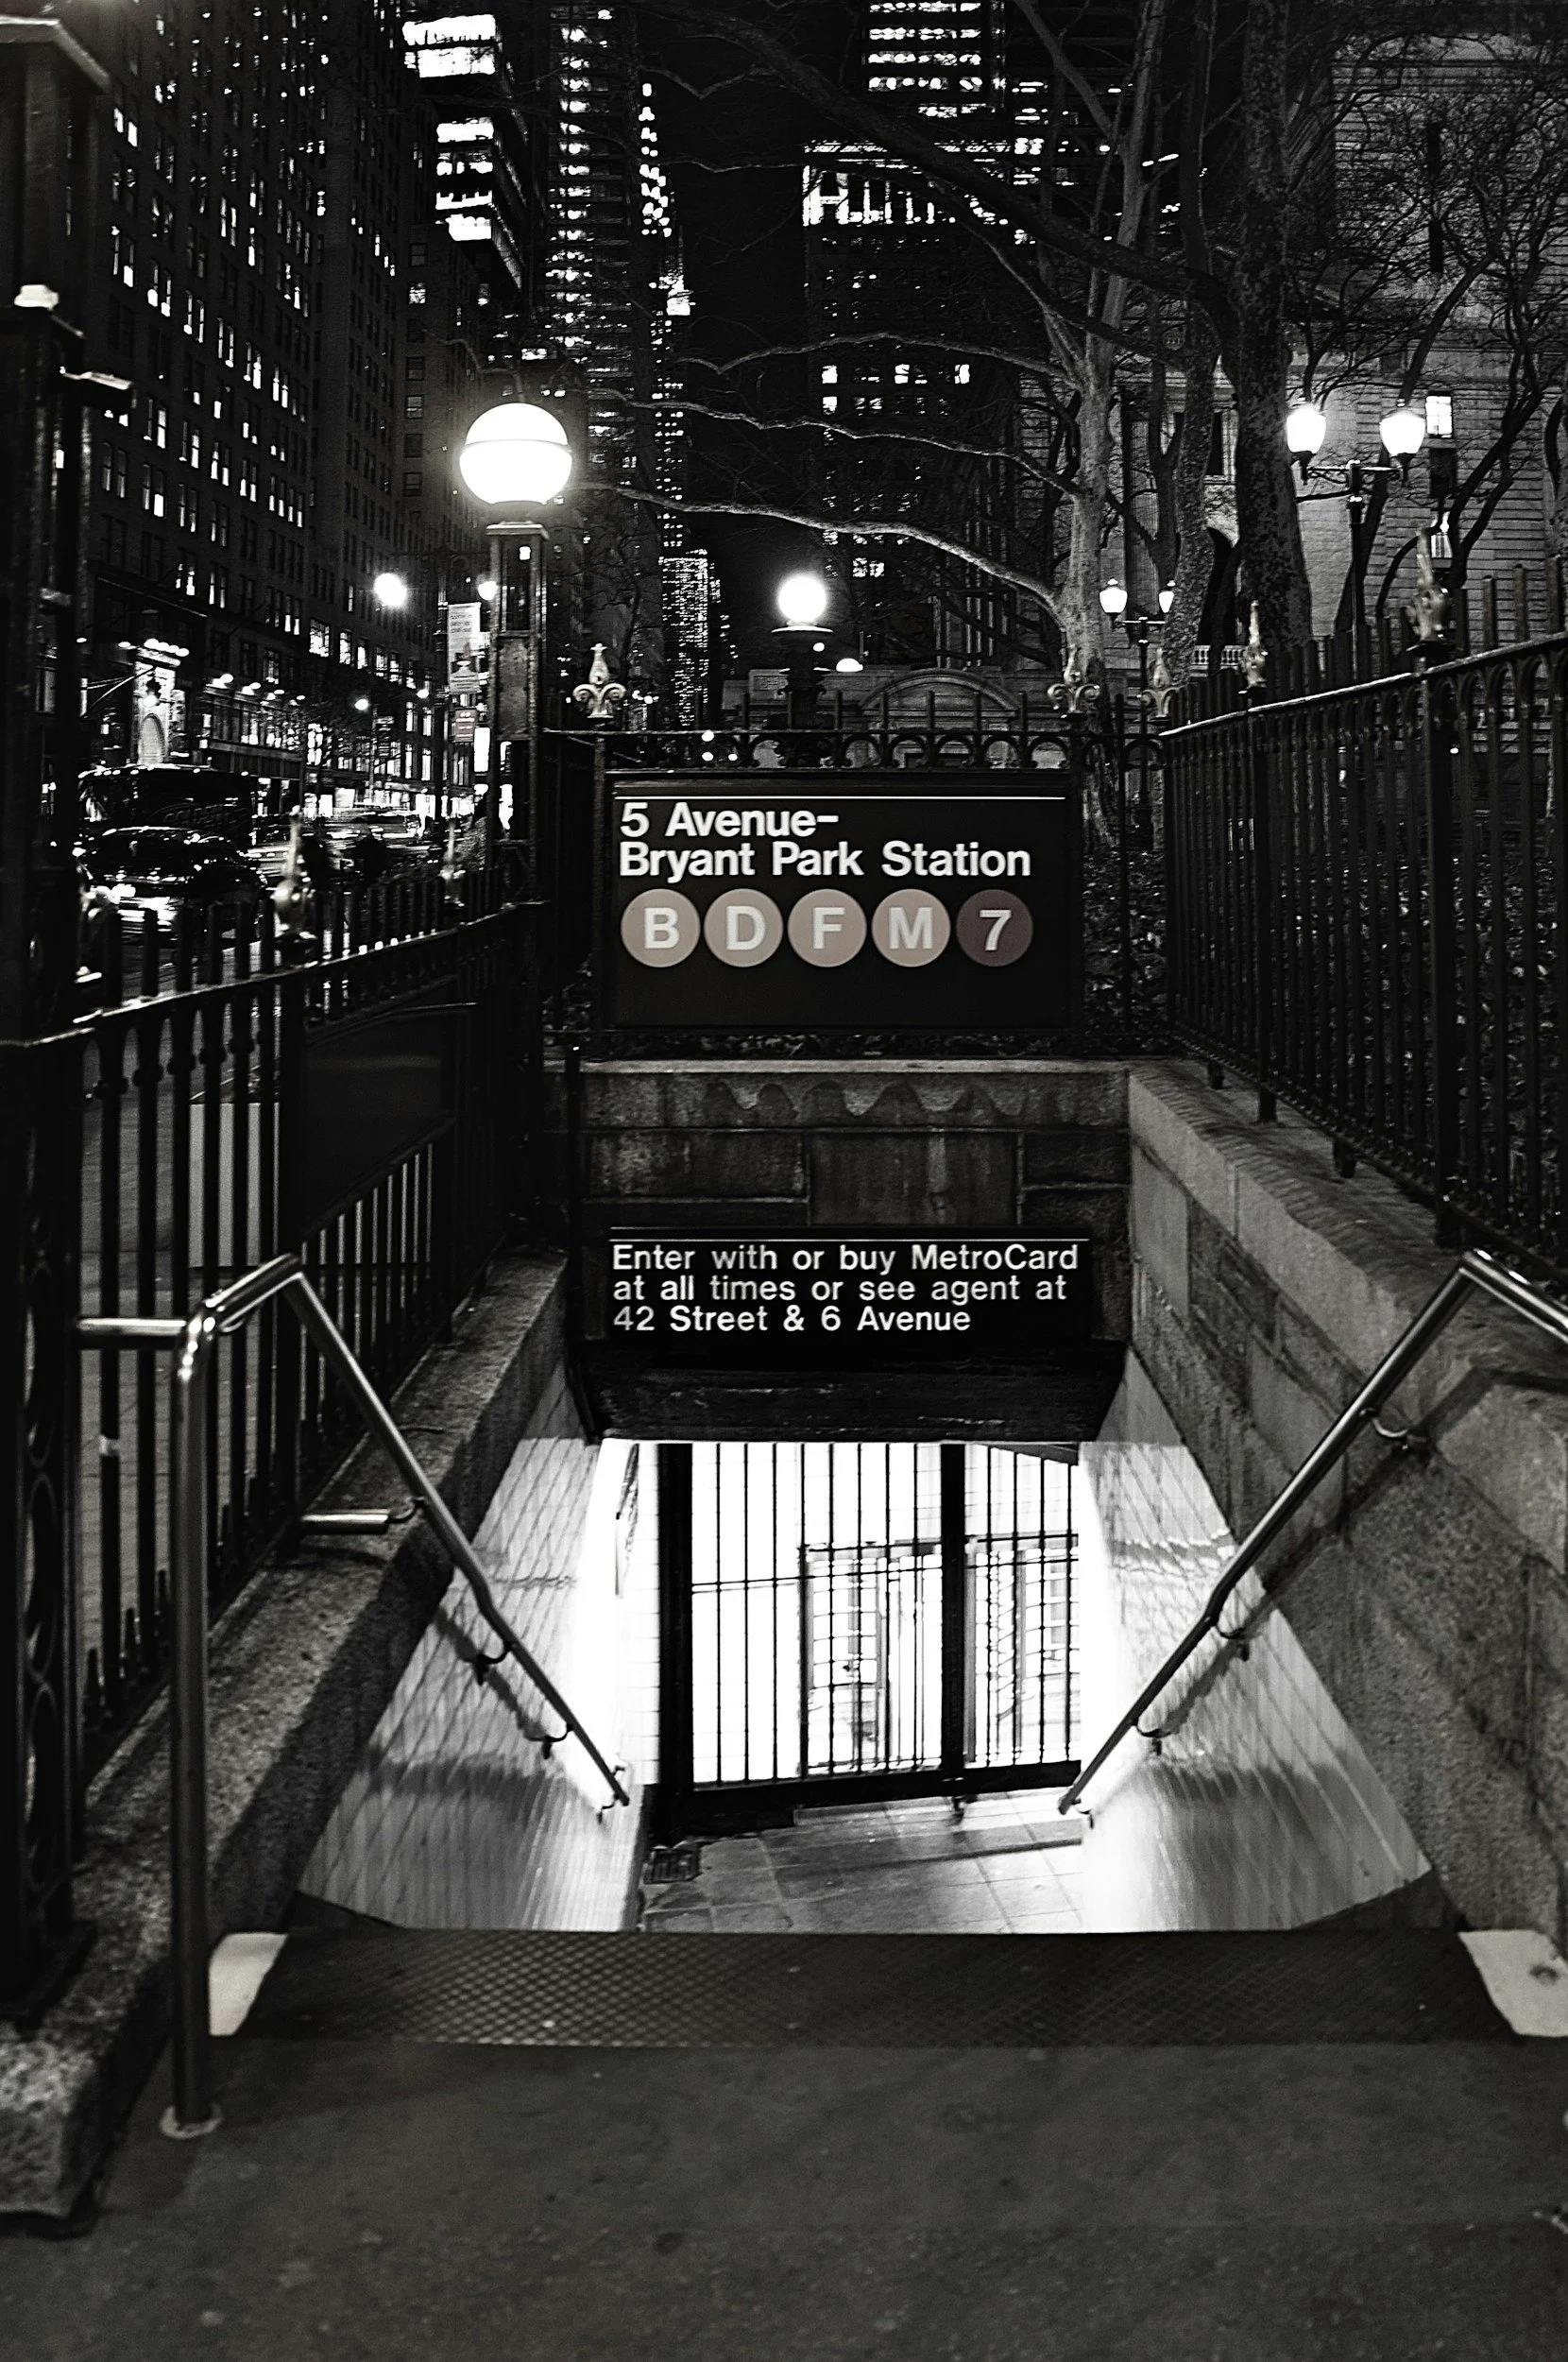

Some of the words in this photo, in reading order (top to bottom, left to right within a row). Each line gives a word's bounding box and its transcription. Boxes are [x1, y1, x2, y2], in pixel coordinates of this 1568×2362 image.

[621, 802, 649, 837] 5
[665, 802, 839, 837] Avenue-
[620, 841, 756, 884] Bryant
[772, 840, 865, 877] Park
[881, 840, 1031, 878] Station
[643, 907, 680, 950] B
[726, 906, 766, 950] D
[812, 907, 845, 950] F
[889, 907, 934, 950] M
[980, 909, 1013, 951] 7
[613, 1244, 696, 1271] Enter
[711, 1244, 777, 1270] with
[792, 1250, 825, 1271] or
[840, 1244, 896, 1275] buy
[912, 1243, 1078, 1271] MetroCard
[613, 1275, 645, 1301] at
[660, 1275, 694, 1301] all
[709, 1275, 796, 1301] times
[810, 1280, 844, 1301] or
[859, 1280, 916, 1301] see
[930, 1275, 1020, 1307] agent
[1035, 1275, 1066, 1301] at
[613, 1306, 656, 1331] 42
[670, 1305, 768, 1332] Street
[783, 1305, 805, 1332] &
[821, 1306, 842, 1332] 6
[857, 1305, 972, 1332] Avenue
